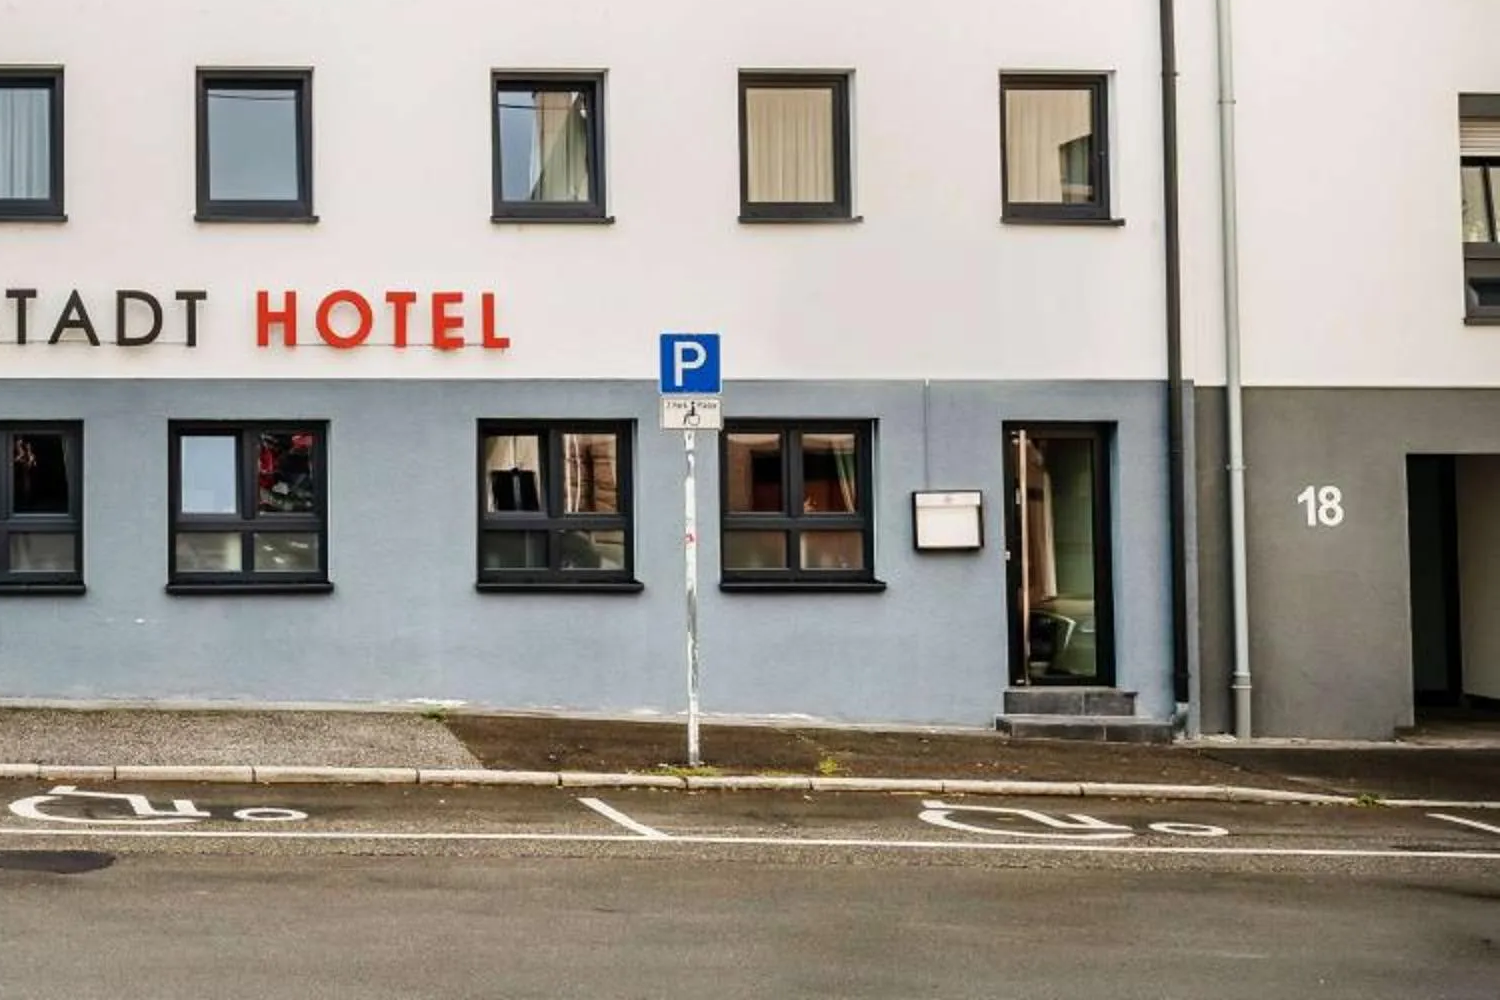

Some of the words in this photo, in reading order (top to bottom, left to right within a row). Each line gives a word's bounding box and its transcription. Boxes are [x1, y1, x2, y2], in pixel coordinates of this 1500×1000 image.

[256, 290, 510, 350] HOTEL
[674, 341, 707, 387] P
[1297, 485, 1345, 527] 18
